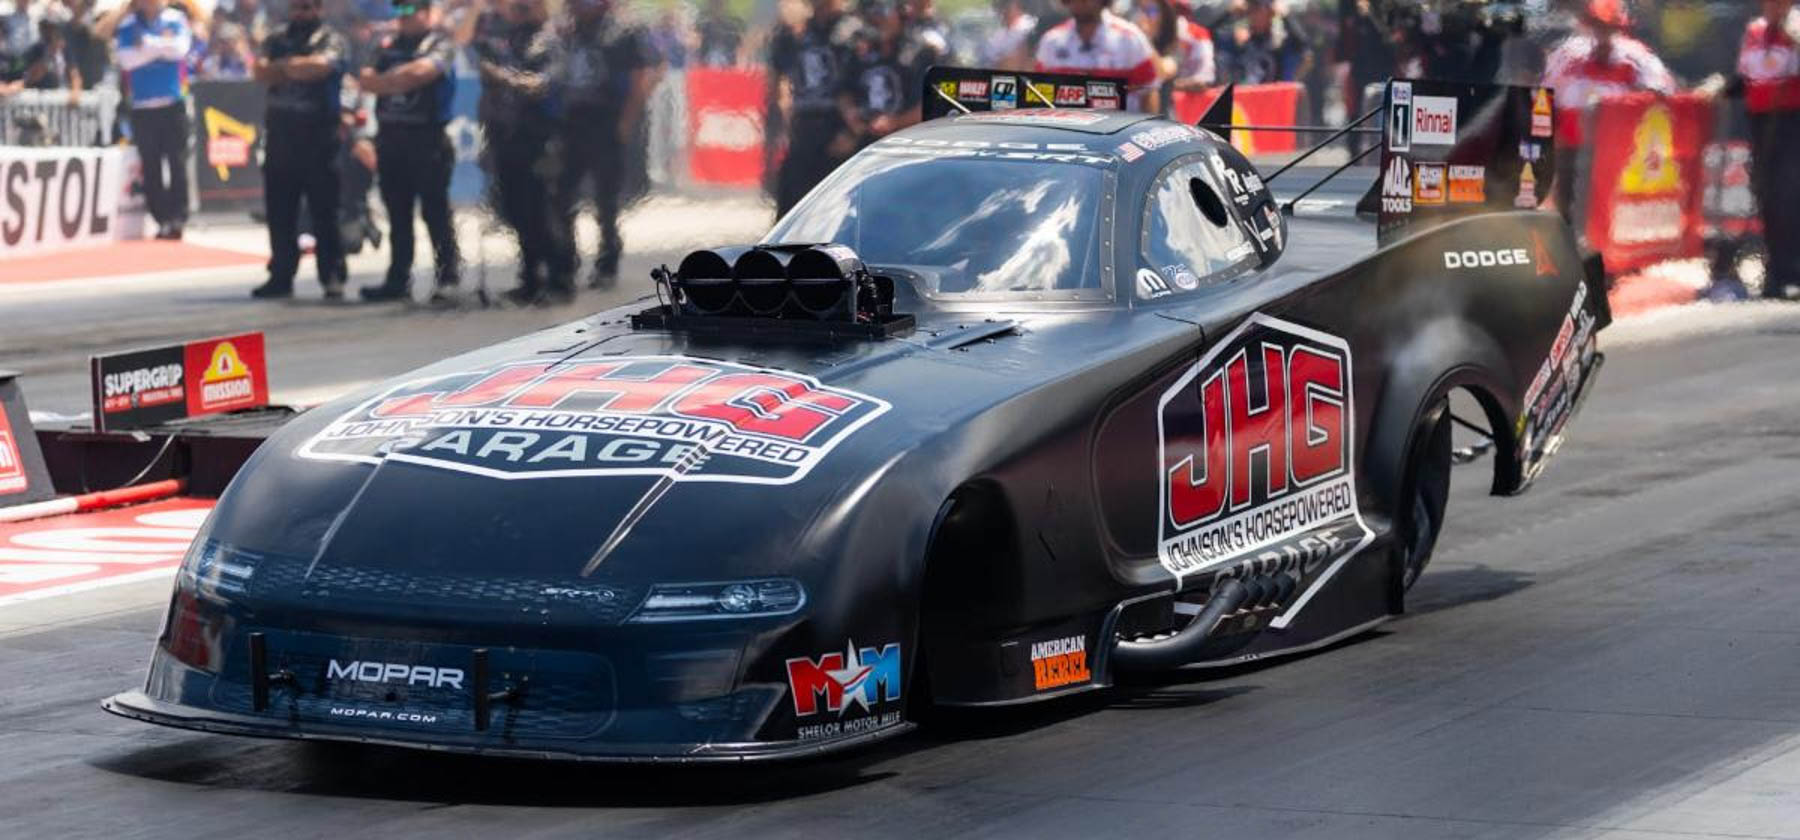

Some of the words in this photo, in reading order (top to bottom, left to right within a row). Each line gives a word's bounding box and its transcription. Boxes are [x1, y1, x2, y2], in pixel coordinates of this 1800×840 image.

[1396, 107, 1404, 143] 1
[1415, 108, 1453, 134] Rinnai
[1382, 156, 1412, 197] MAC
[0, 156, 109, 246] STOL
[1382, 198, 1412, 213] TOOLS
[1443, 248, 1531, 269] DODGE
[104, 363, 183, 397] SUPERGRIP
[368, 361, 864, 444] JHG
[378, 428, 712, 470] GARAGE
[520, 413, 811, 463] HORSEPOWERED
[1168, 341, 1344, 531] JHG
[1244, 482, 1351, 548] HORSEPOWERED
[1166, 519, 1245, 571] JOHNSON'S
[1031, 635, 1086, 662] AMERICAN
[326, 658, 465, 690] MOPAR
[1032, 651, 1092, 690] REBEL
[329, 706, 437, 723] MOPAR.COM
[797, 722, 841, 740] SHELOR
[843, 714, 879, 733] MOTOR
[881, 709, 902, 726] MILE
